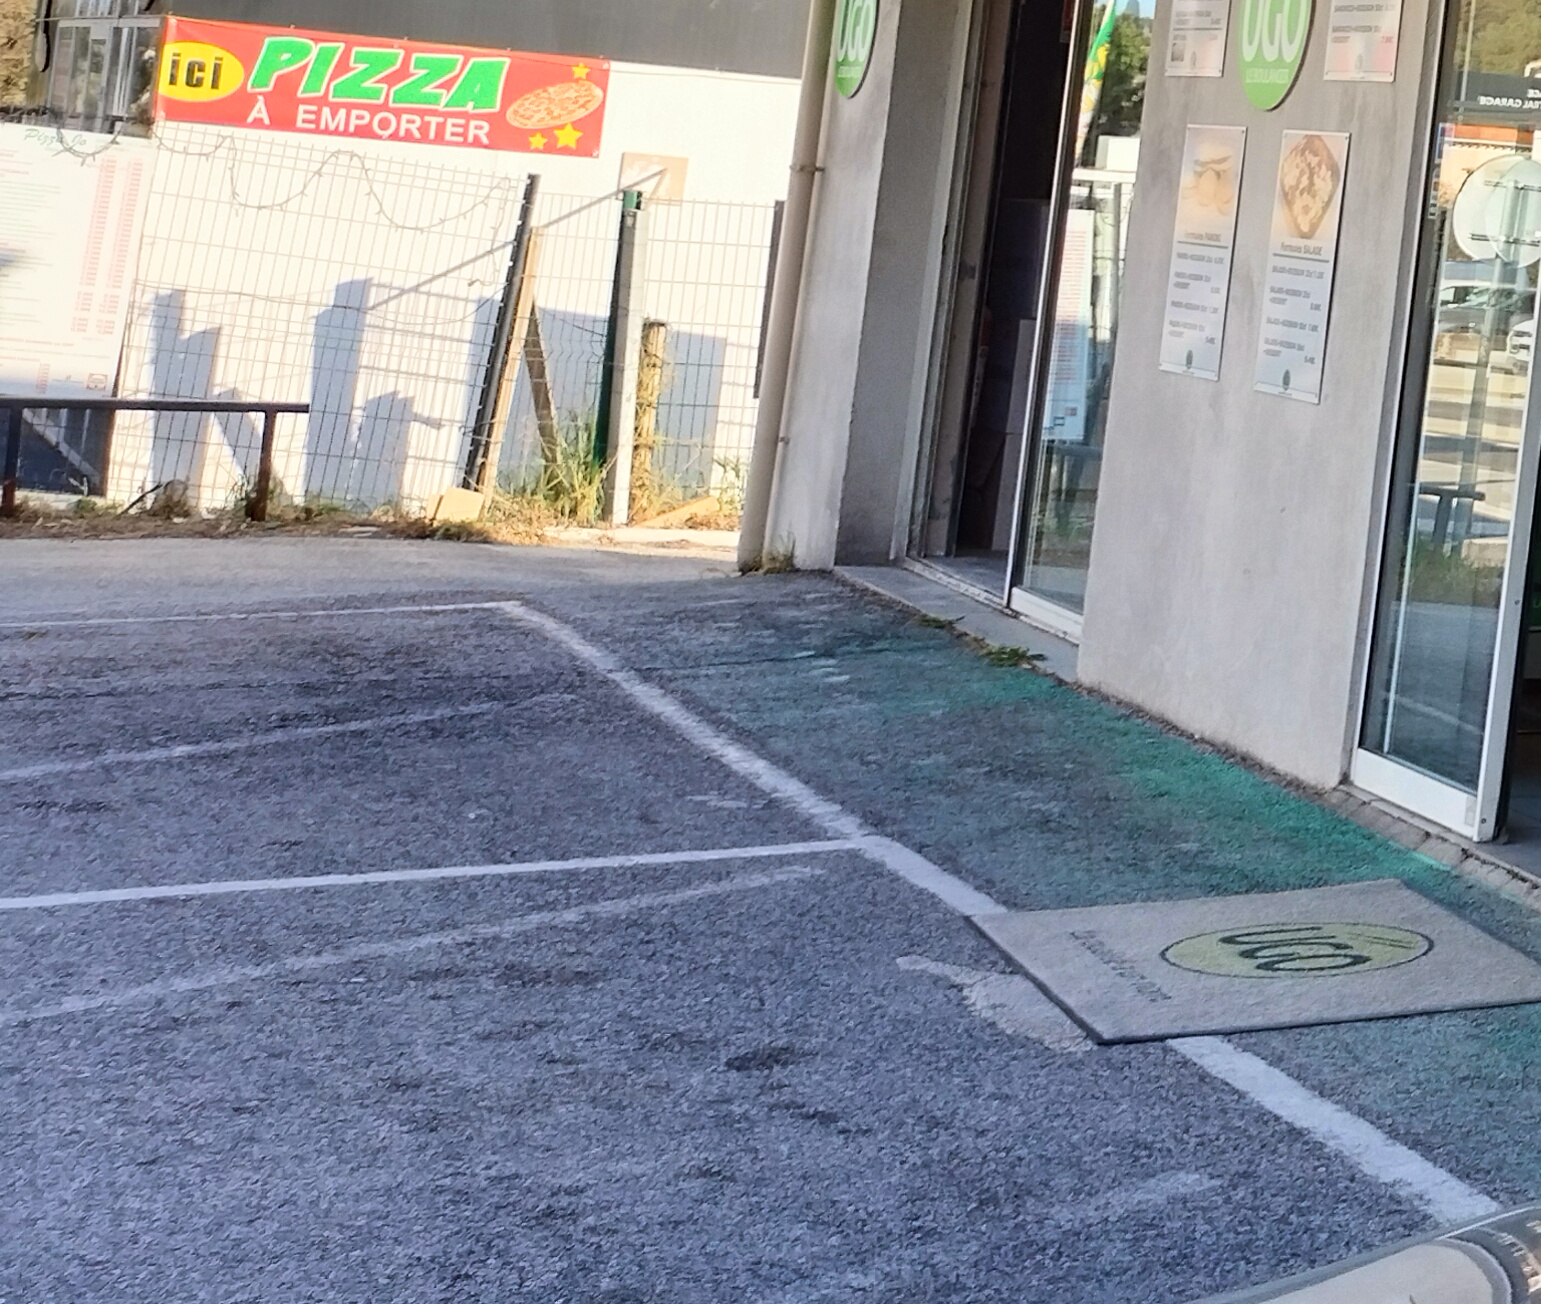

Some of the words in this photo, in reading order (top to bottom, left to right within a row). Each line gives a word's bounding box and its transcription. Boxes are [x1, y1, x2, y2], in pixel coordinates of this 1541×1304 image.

[169, 52, 223, 90] ici
[248, 36, 511, 114] PIZZA
[248, 95, 270, 126] À
[296, 105, 490, 144] EMPORTER
[1218, 925, 1373, 972] UGO
